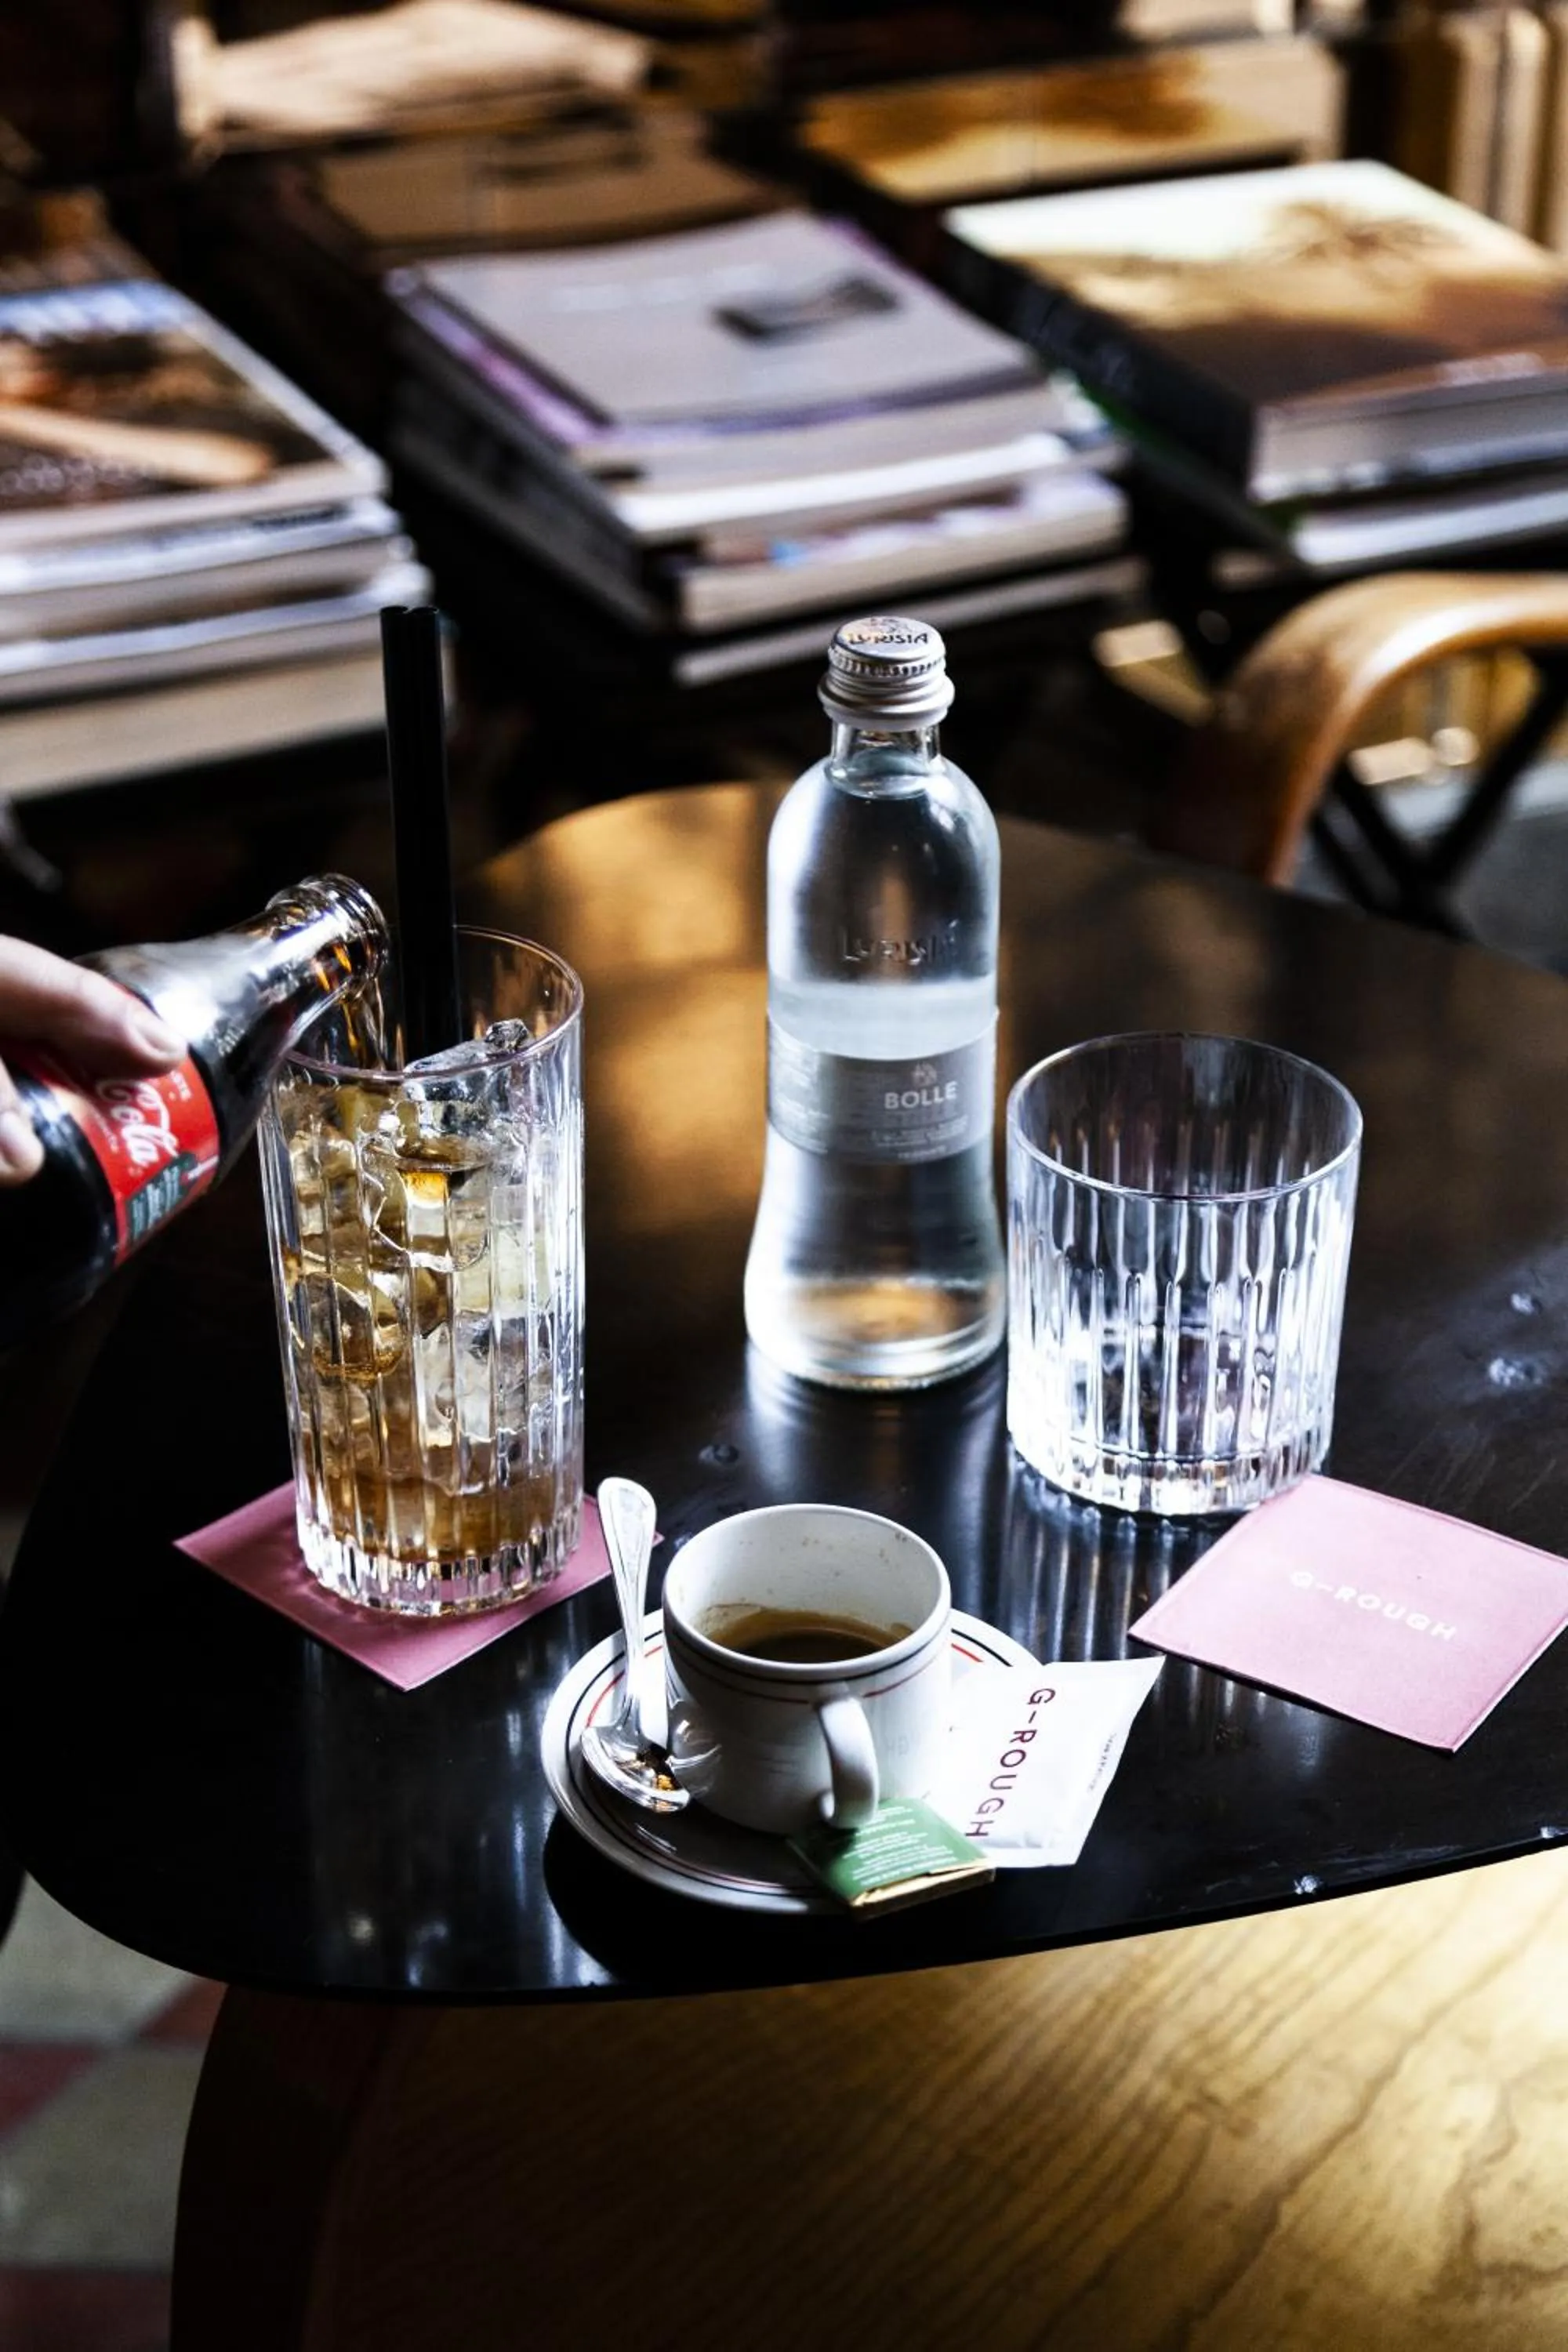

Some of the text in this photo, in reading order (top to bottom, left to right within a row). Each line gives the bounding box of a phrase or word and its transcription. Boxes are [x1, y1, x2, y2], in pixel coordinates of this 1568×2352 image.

[884, 1080, 958, 1110] BOLLE
[1290, 1570, 1456, 1639] G-ROUGH
[965, 1687, 1056, 1837] G-ROUGH
